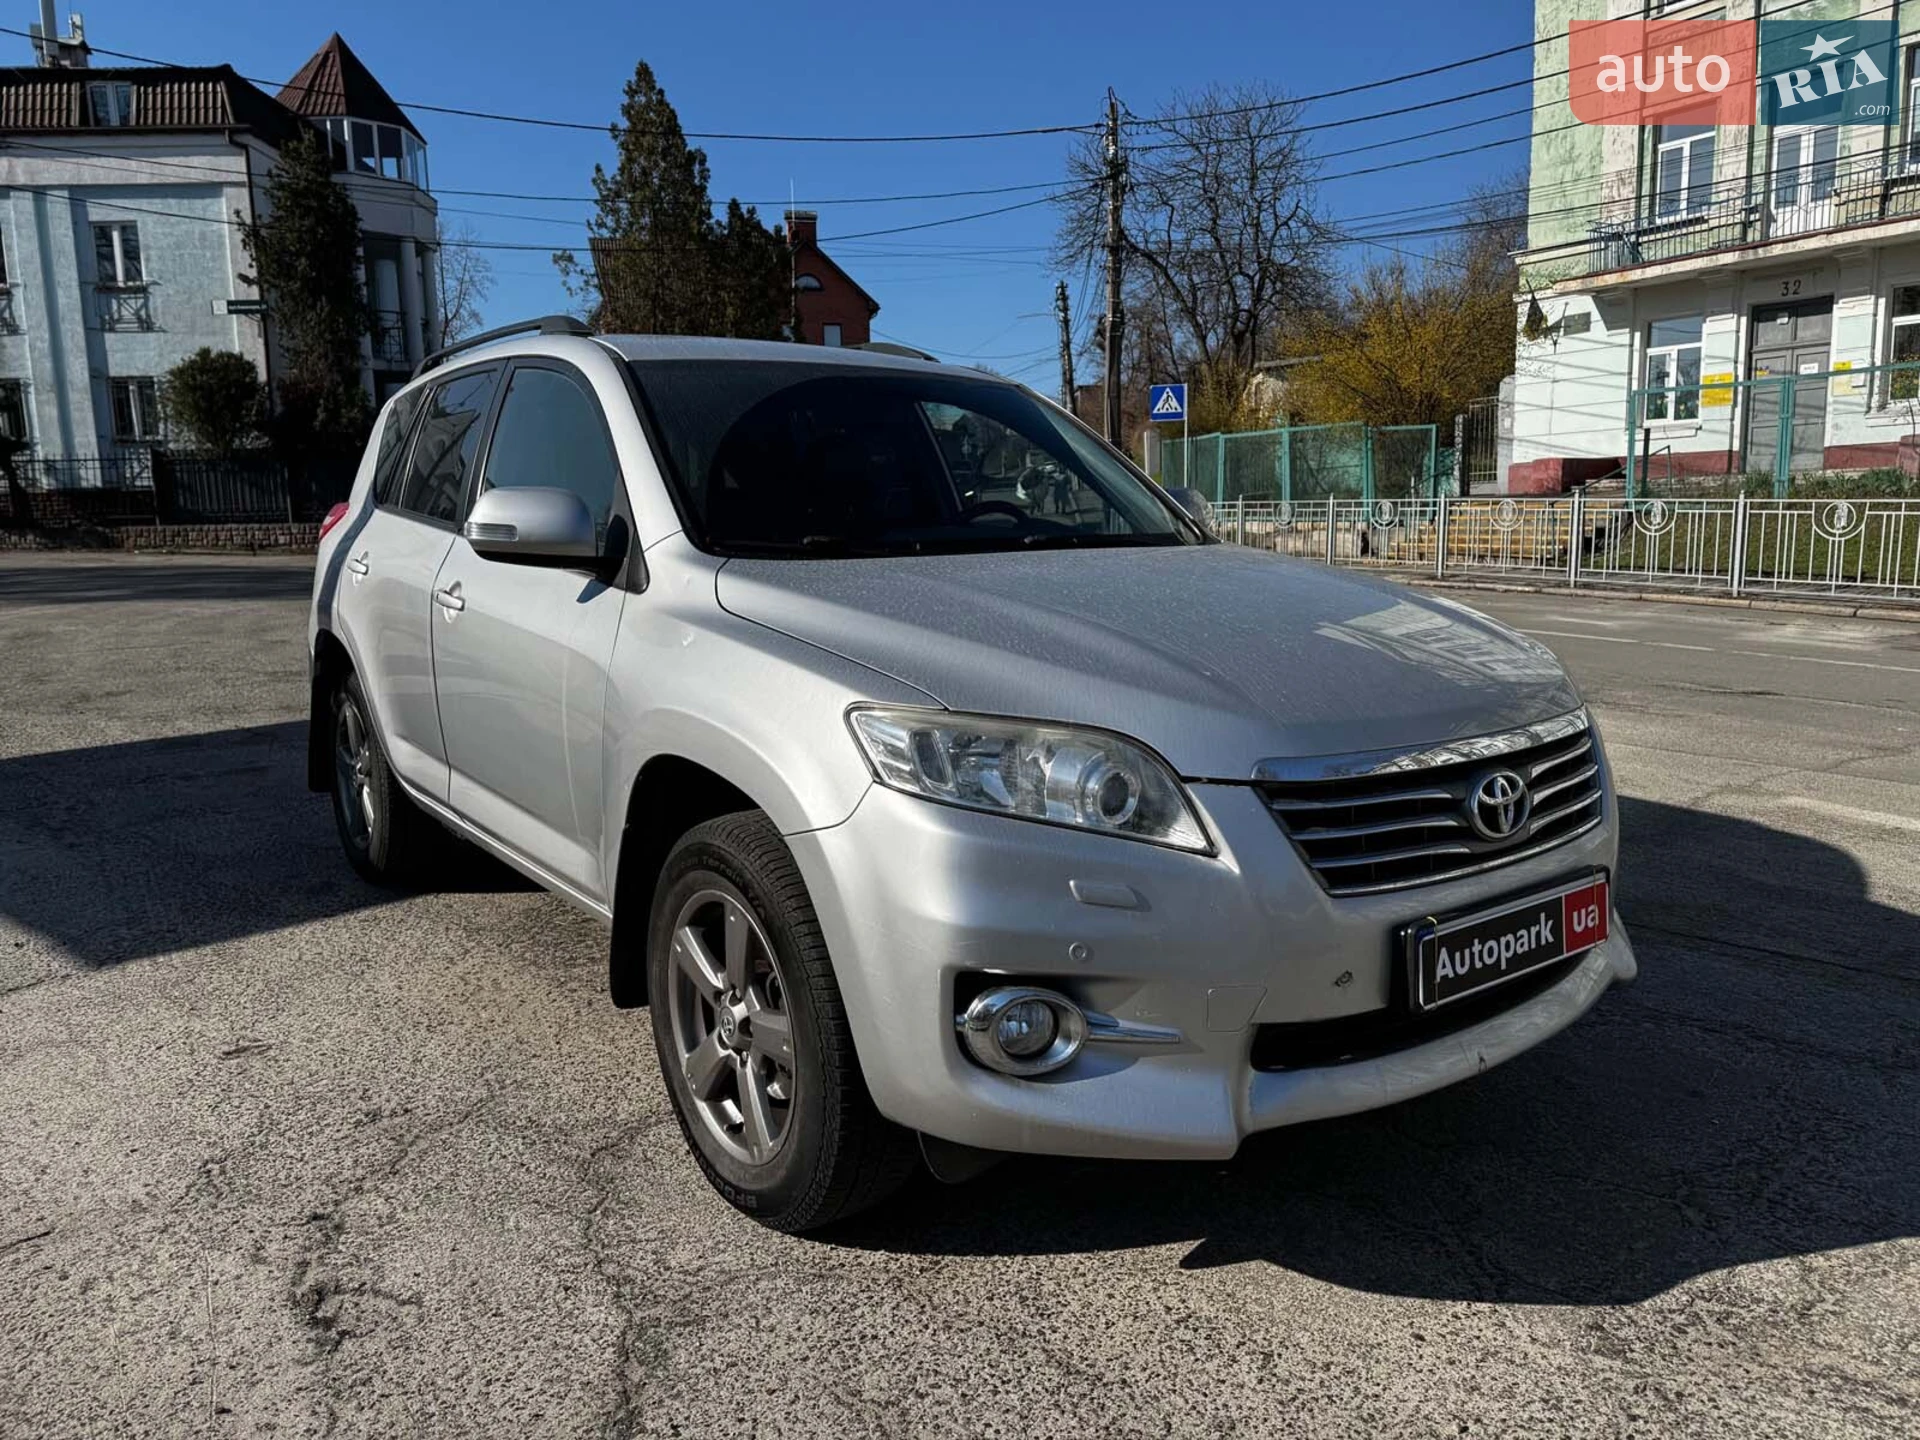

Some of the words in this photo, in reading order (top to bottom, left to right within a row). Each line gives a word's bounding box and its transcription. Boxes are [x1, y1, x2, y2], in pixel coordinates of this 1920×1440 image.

[1781, 279, 1802, 297] 32
[1435, 911, 1555, 983] Autopark
[1572, 903, 1599, 933] ua
